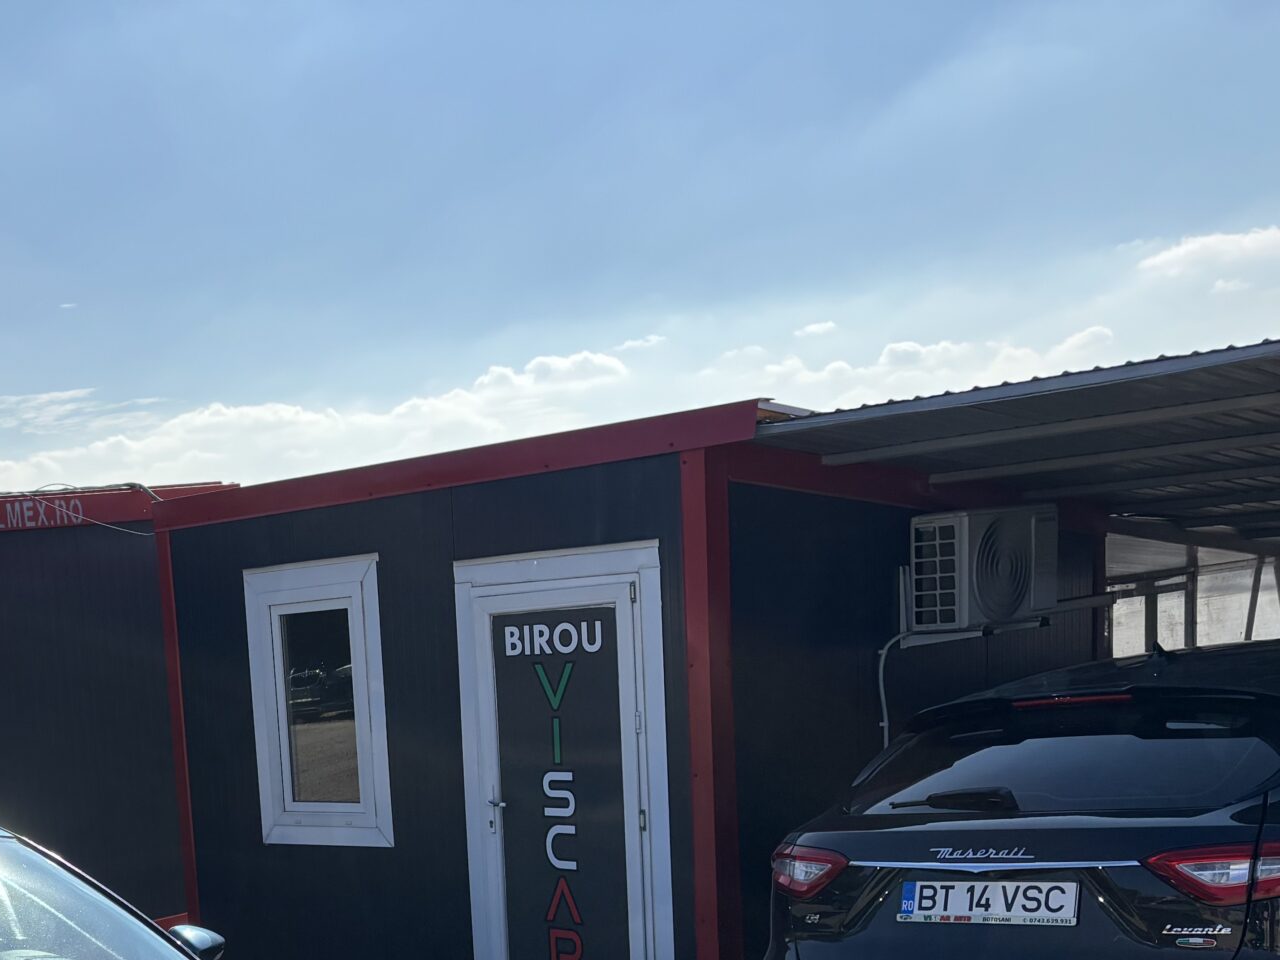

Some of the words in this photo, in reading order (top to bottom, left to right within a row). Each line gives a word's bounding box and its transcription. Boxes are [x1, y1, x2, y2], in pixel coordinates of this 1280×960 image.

[504, 620, 603, 657] BIROU
[929, 847, 1035, 859] Maserati
[917, 884, 956, 912] BT
[966, 884, 992, 912] 14
[1001, 885, 1067, 913] VSC
[901, 900, 914, 911] RO
[1162, 924, 1232, 935] Levante
